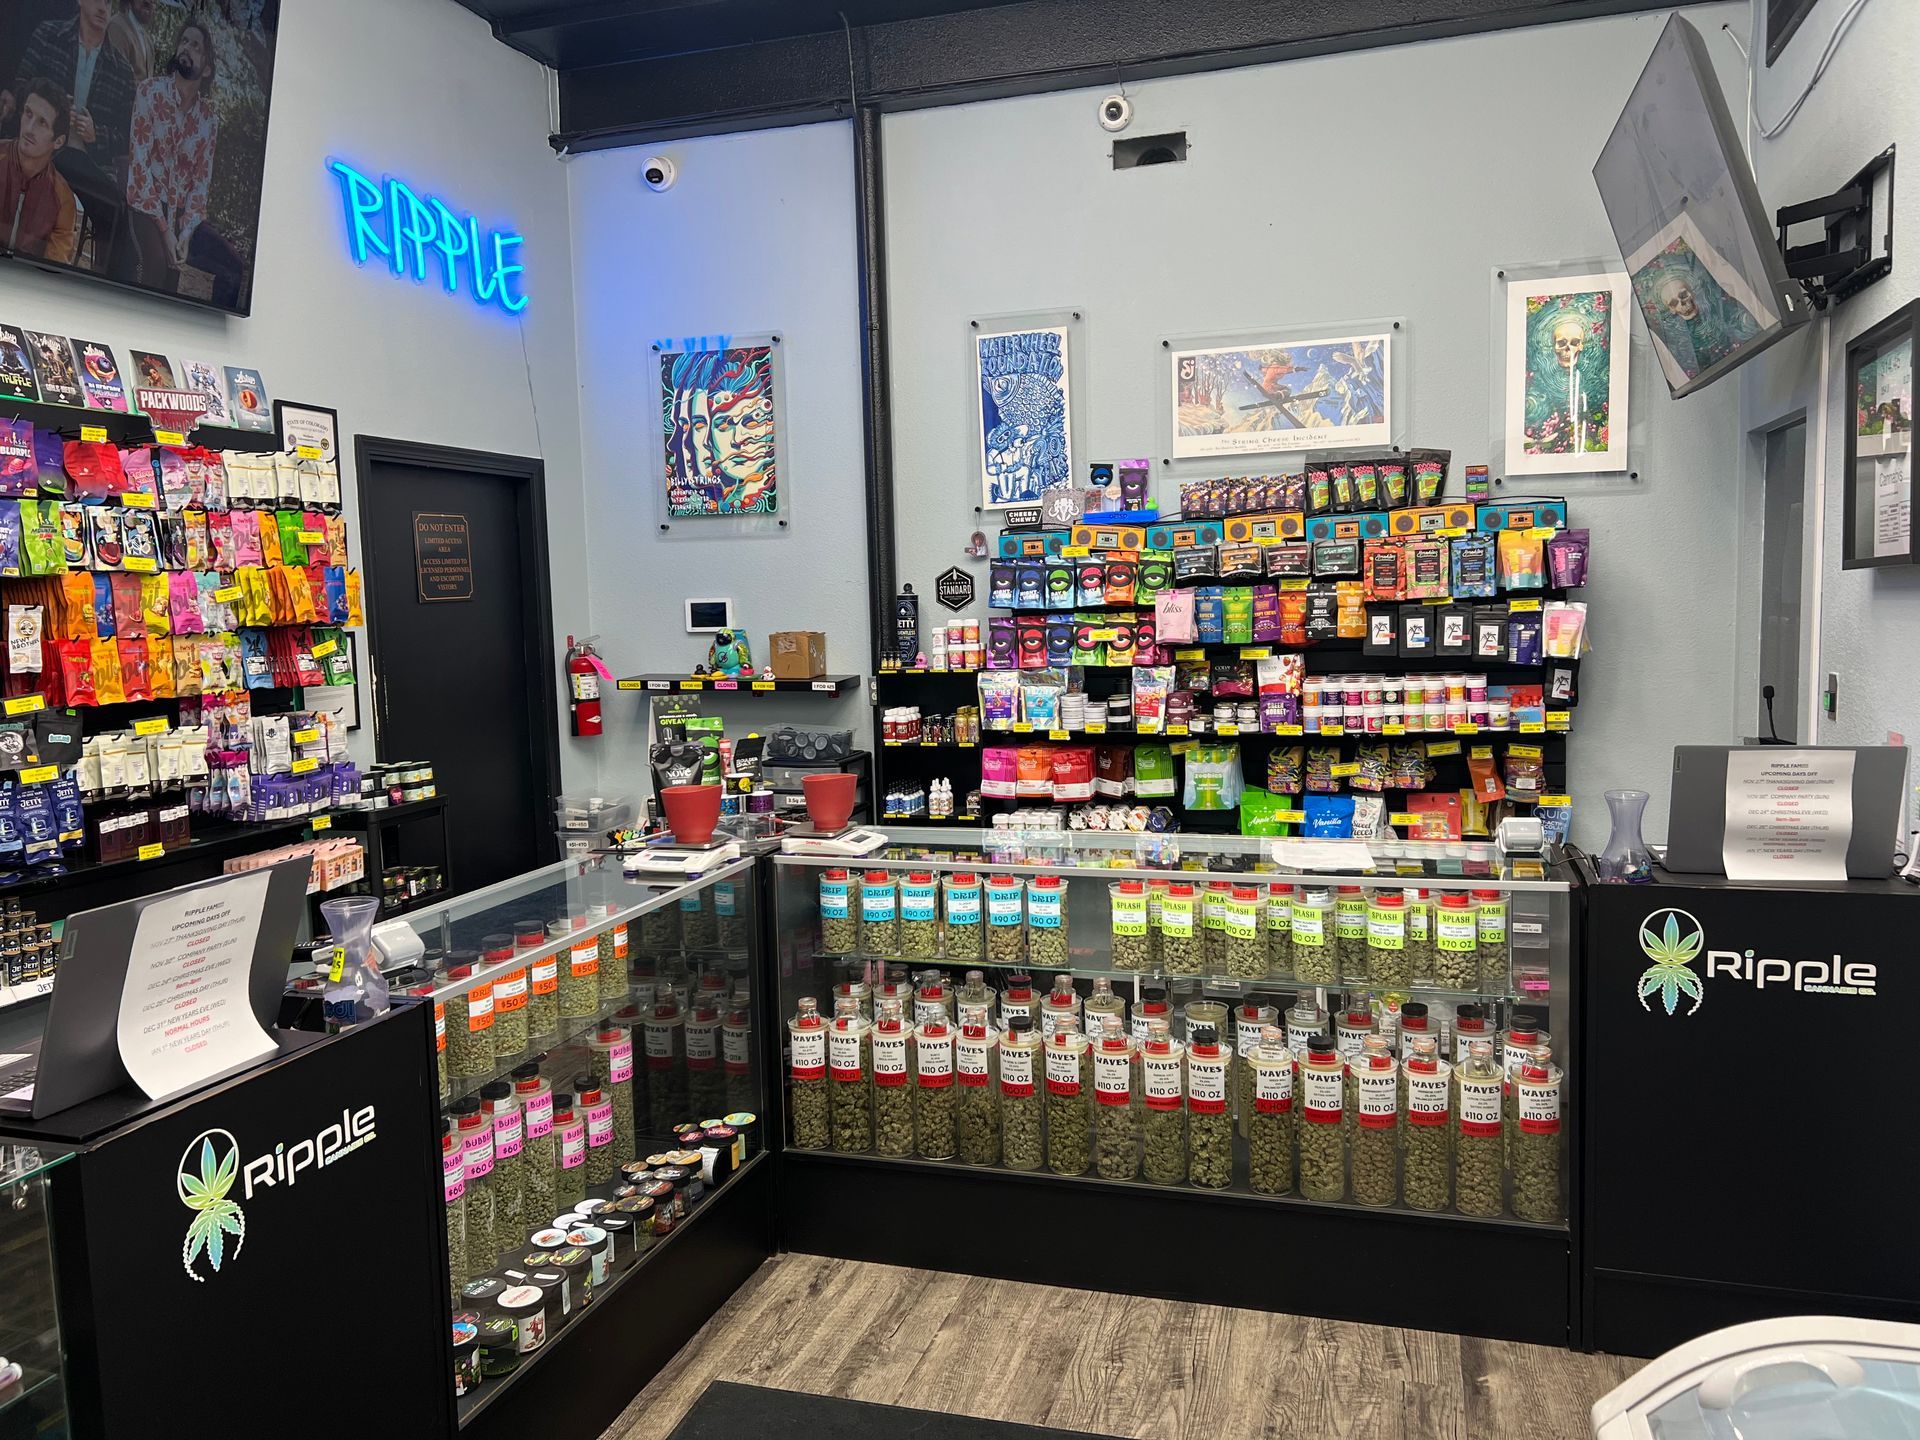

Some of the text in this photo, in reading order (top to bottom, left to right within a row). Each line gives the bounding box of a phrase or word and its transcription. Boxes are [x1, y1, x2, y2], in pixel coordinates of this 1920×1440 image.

[331, 160, 529, 311] RIPPLE
[979, 333, 1061, 357] WATERWHEEL
[982, 355, 1064, 382] FOUNDATION
[140, 390, 207, 412] PACKWOODS
[306, 420, 329, 432] COLORADO
[670, 476, 720, 486] BILLY STRINGS
[420, 523, 465, 532] DO NOT ENTER
[940, 584, 972, 595] STANDARD
[1162, 602, 1182, 614] bliss
[11, 637, 30, 645] NEWT
[56, 788, 74, 797] JETTY
[20, 797, 42, 808] JETTY
[1313, 818, 1341, 828] Vanilla
[867, 889, 890, 897] DRIP
[907, 889, 930, 898] DRIP
[953, 891, 977, 900] DRIP
[994, 892, 1020, 900] DRIP
[1032, 895, 1056, 903] DRIP
[1116, 901, 1141, 910] SPLASH
[1164, 902, 1187, 910] SPLASH
[1337, 904, 1363, 912] SPLASH
[185, 904, 217, 917] RIPPLE FAM
[832, 908, 843, 916] OZ
[880, 911, 892, 919] OZ
[906, 910, 916, 918] $90
[1227, 906, 1249, 915] SPLASH
[1293, 909, 1315, 918] SPLASH
[172, 909, 231, 931] UPCOMING DAYS OFF
[953, 913, 980, 922] $90 OZ
[994, 915, 1021, 923] $90 OZ
[1371, 911, 1397, 921] SPLASH
[1442, 914, 1470, 924] SPLASH
[1046, 917, 1058, 925] OZ
[1116, 925, 1142, 933] $70 OZ
[187, 936, 210, 947] CLOSED
[1369, 937, 1396, 947] $70 OZ
[1442, 940, 1472, 948] $70 OZ
[182, 957, 206, 968] CLOSED
[577, 964, 593, 973] $50
[1706, 949, 1876, 990] Ripple
[1804, 984, 1857, 995] CANNABIS
[174, 997, 198, 1010] CLOSED
[501, 998, 518, 1009] $50
[1001, 1006, 1027, 1015] WAVES
[164, 1015, 210, 1037] NORMAL HOURS
[793, 1034, 823, 1043] WAVES
[831, 1036, 858, 1044] WAVES
[185, 1040, 208, 1053] CLOSED
[874, 1040, 904, 1048] WAVES
[919, 1041, 950, 1050] WAVES
[957, 1046, 984, 1054] WAVES
[1001, 1049, 1030, 1058] WAVES
[1047, 1052, 1076, 1061] WAVES
[796, 1057, 822, 1067] $110 OZ
[1096, 1057, 1128, 1066] WAVES
[1146, 1061, 1179, 1070] WAVES
[1190, 1063, 1222, 1073] WAVES
[1017, 1074, 1030, 1082] OZ
[1260, 1069, 1291, 1078] WAVES
[1307, 1073, 1341, 1082] WAVES
[1098, 1082, 1126, 1090] $110 OZ
[1362, 1078, 1395, 1086] WAVES
[1412, 1081, 1447, 1089] WAVES
[1149, 1086, 1179, 1095] $110 OZ
[1192, 1089, 1221, 1098] $110 OZ
[1464, 1085, 1500, 1094] WAVES
[1522, 1089, 1558, 1097] WAVES
[1262, 1092, 1278, 1100] $110
[1309, 1100, 1340, 1108] $110 OZ
[1412, 1103, 1429, 1111] $110
[1465, 1112, 1483, 1120] $110
[534, 1124, 548, 1134] $60
[244, 1105, 376, 1200] Ripple
[503, 1144, 518, 1154] $60
[471, 1164, 486, 1174] $60
